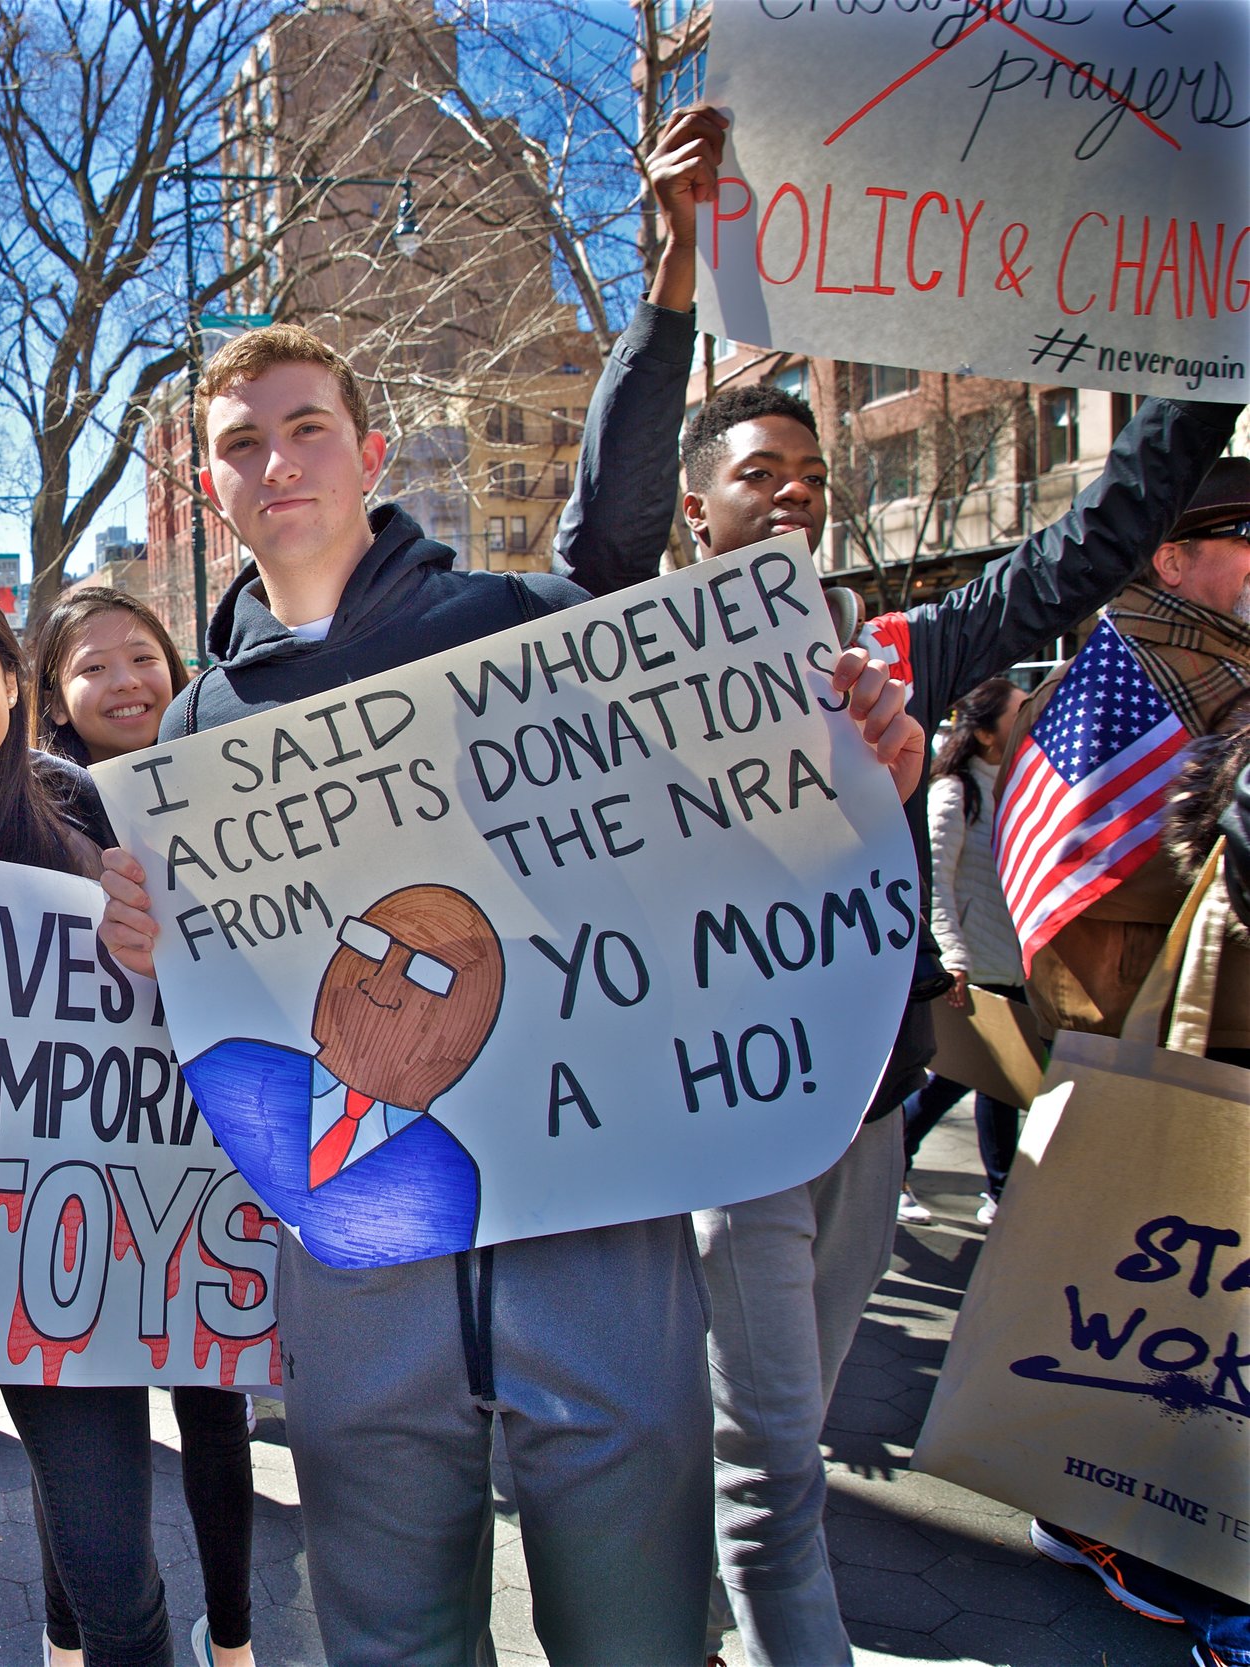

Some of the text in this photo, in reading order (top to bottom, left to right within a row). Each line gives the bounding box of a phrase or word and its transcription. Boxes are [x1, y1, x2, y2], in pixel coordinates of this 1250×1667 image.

[961, 49, 1250, 162] prayers
[711, 177, 985, 298] POLICY
[994, 222, 1034, 298] &
[1028, 327, 1246, 390] #neveragain
[132, 551, 810, 816] I SAID WHOEVER
[166, 641, 851, 891] ACCEPTS DONATIONS
[175, 748, 838, 962] FROM THE NRA
[528, 869, 916, 1019] YO MOM'S
[548, 1017, 817, 1138] A HO!
[1063, 1456, 1138, 1498] HIGH
[1142, 1481, 1209, 1526] LINE
